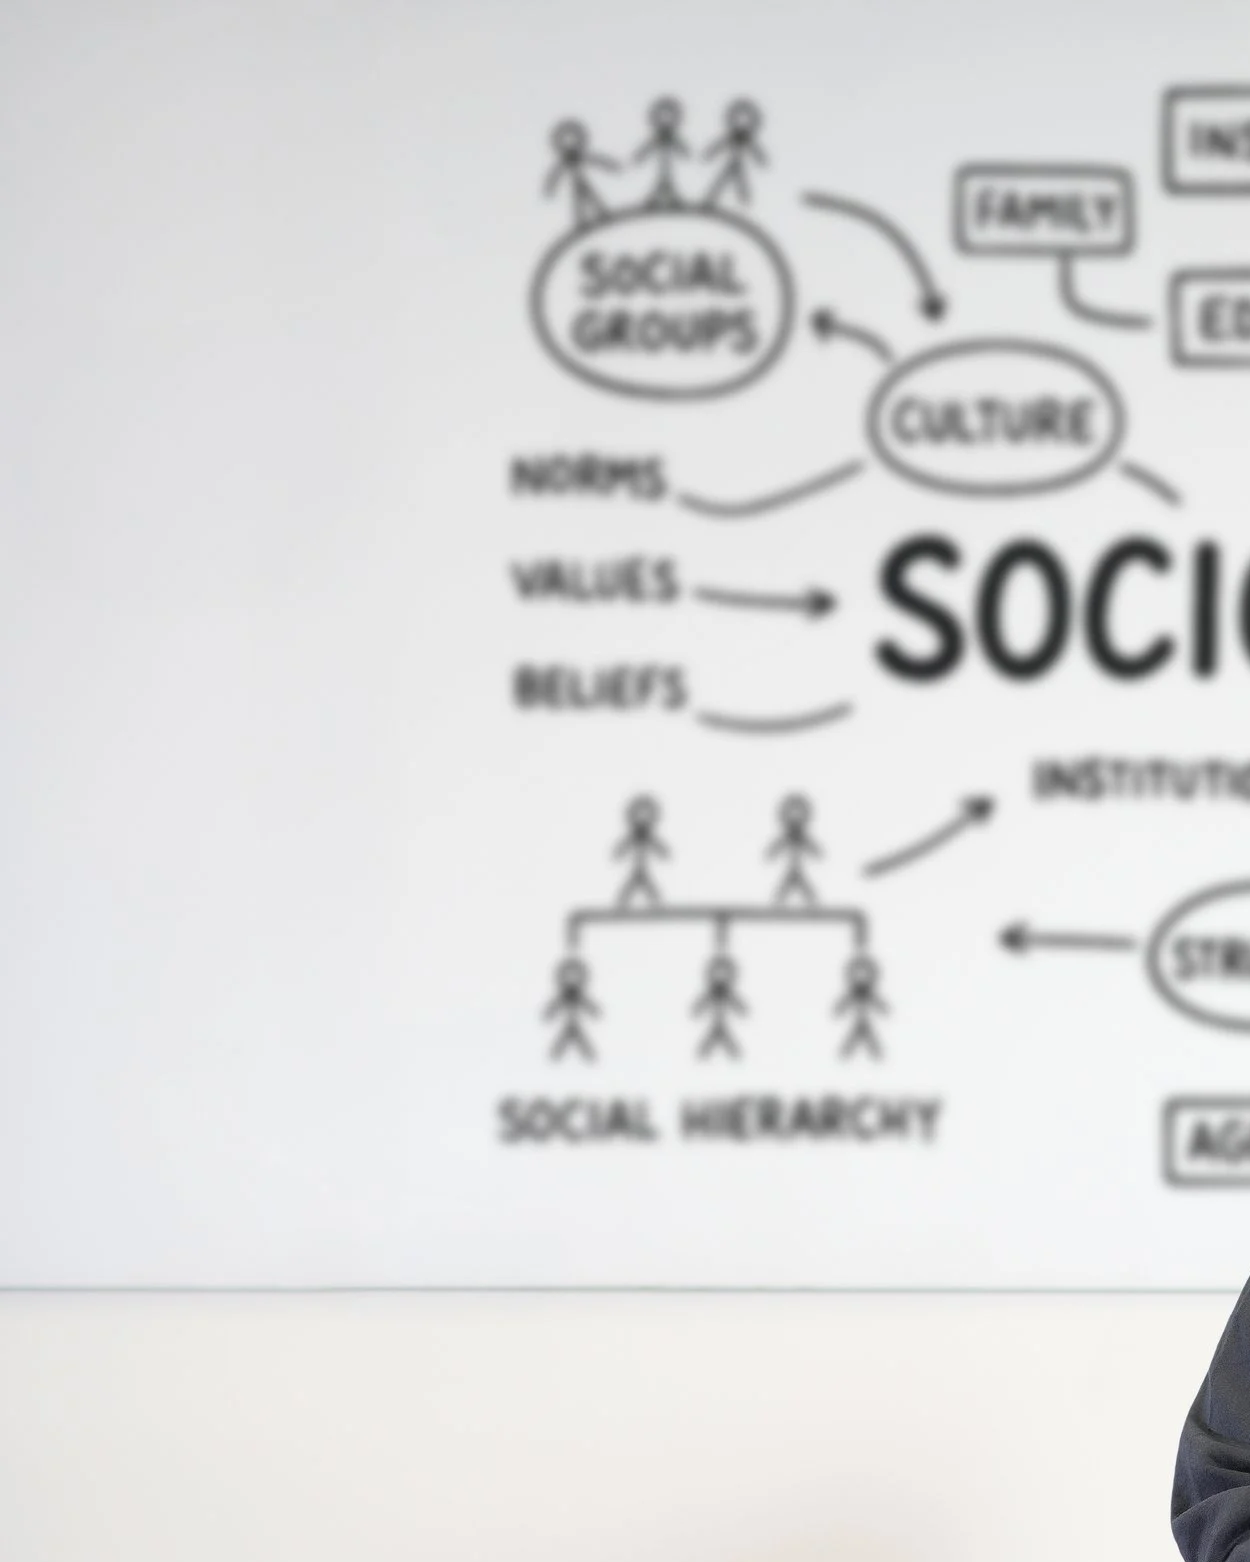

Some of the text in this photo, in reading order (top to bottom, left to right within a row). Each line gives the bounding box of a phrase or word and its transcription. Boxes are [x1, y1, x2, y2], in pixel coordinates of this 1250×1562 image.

[971, 186, 1120, 234] FAMILY
[577, 250, 746, 299] SOCIAL
[571, 308, 760, 357] GROUPS
[889, 395, 1096, 447] CULTURE
[508, 451, 669, 503] NORMS
[509, 554, 684, 606] VALUES
[511, 662, 689, 713] BELIEFS
[495, 1094, 942, 1146] SOCIAL HIERARCHY
